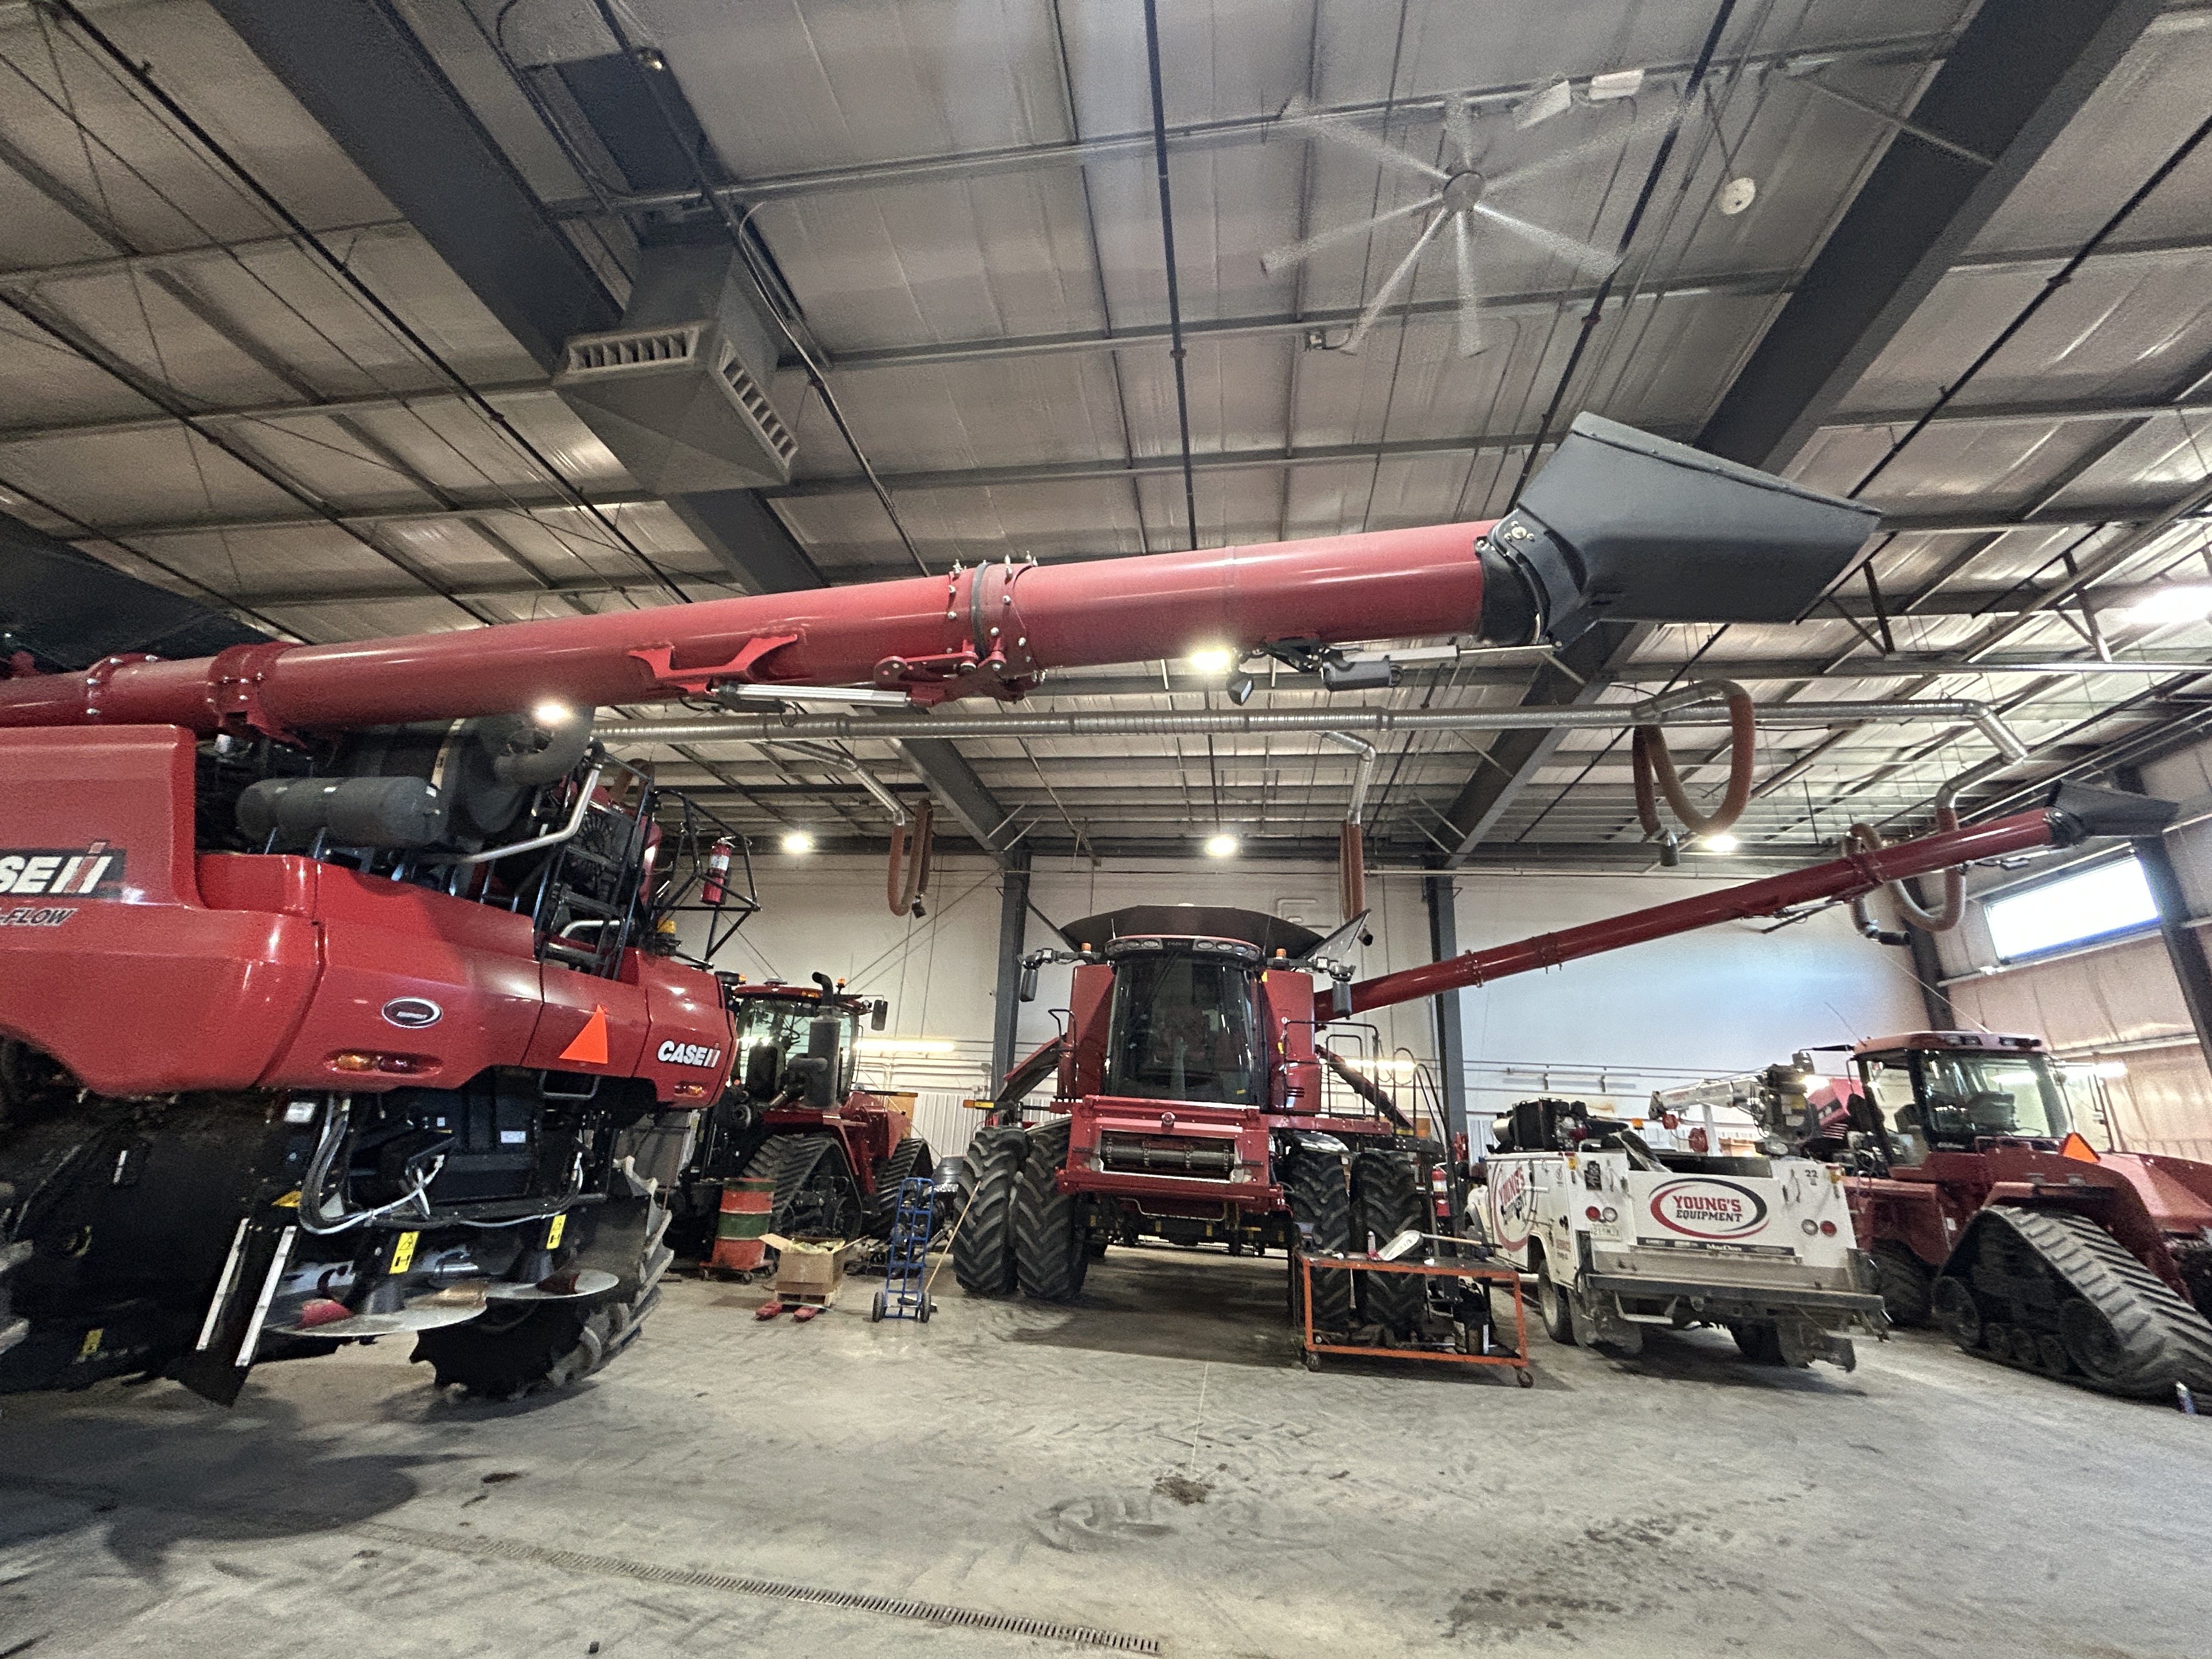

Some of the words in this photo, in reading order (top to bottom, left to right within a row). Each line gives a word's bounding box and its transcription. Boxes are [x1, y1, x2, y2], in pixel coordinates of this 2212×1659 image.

[1805, 1169, 1818, 1178] 22
[1673, 1195, 1742, 1212] YOUNG'S
[1677, 1210, 1742, 1222] EQUIPMENT
